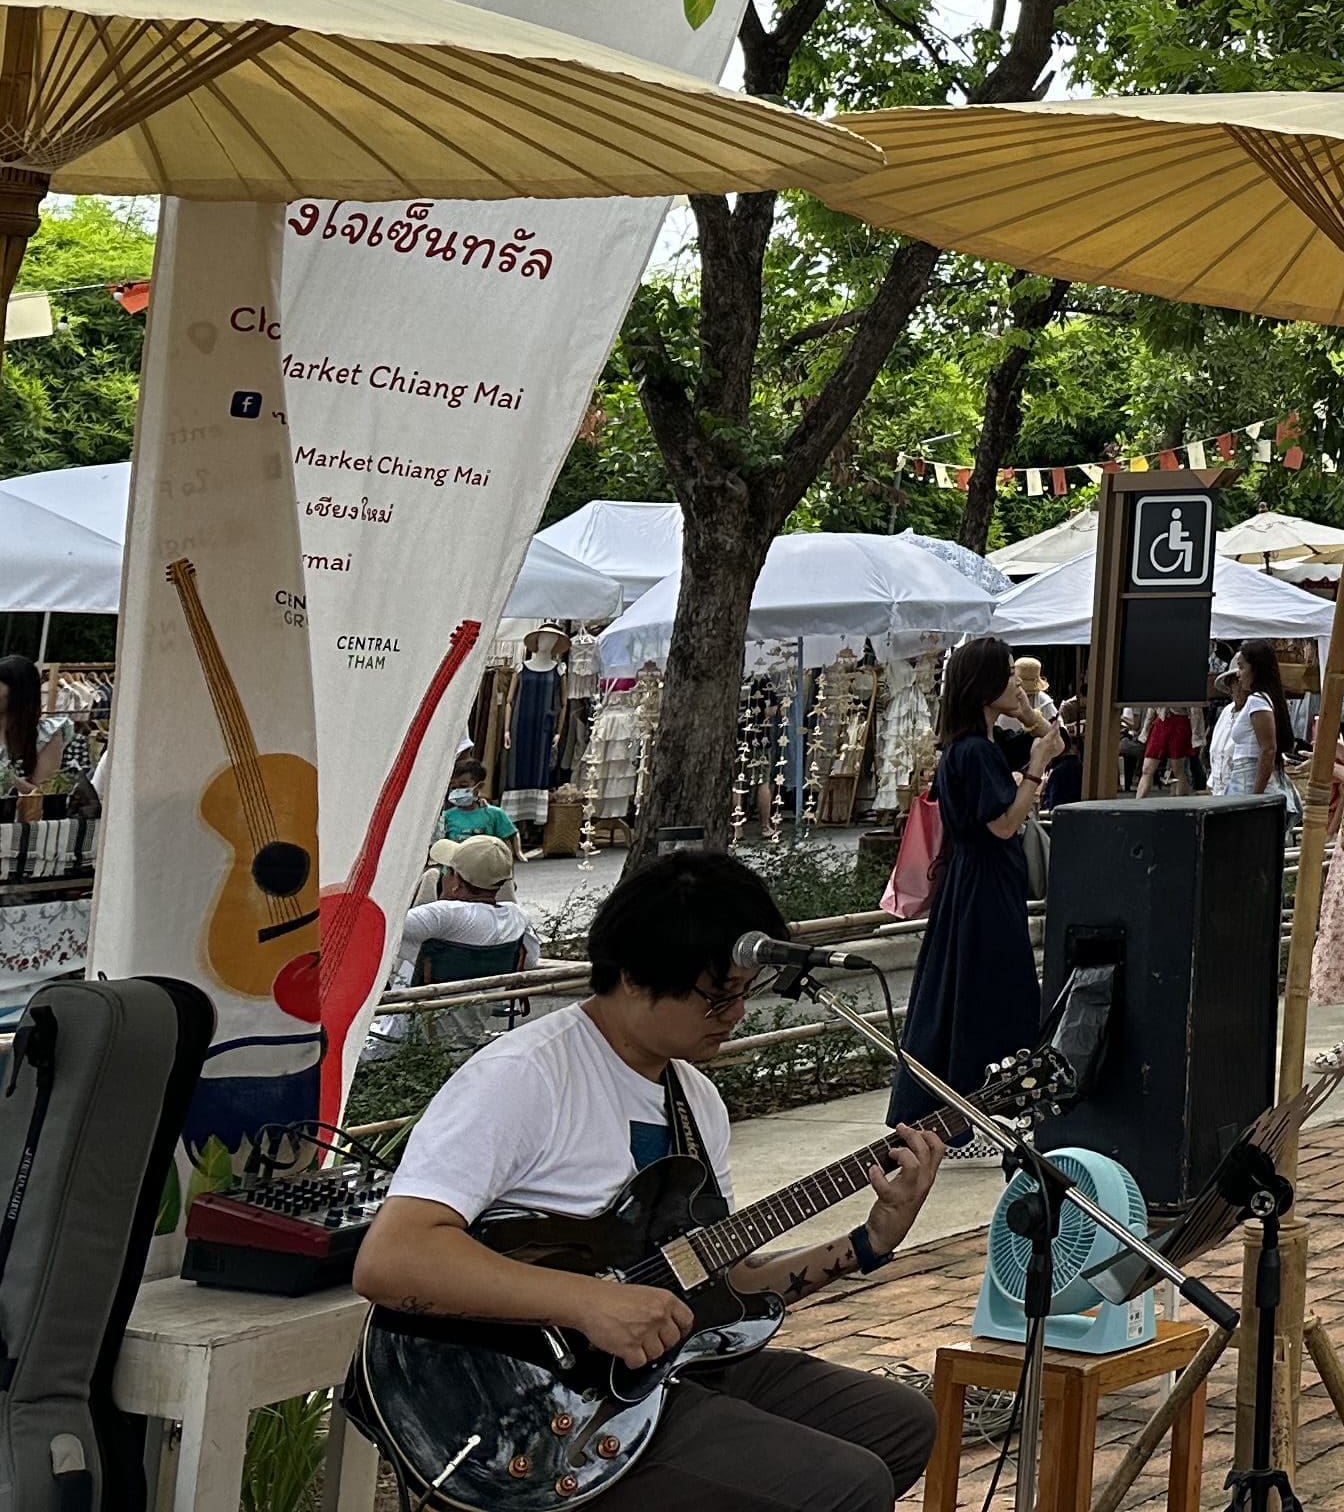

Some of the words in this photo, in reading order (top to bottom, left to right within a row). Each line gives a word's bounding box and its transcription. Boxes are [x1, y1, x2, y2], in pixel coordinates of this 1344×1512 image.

[369, 365, 468, 408] Chiang
[474, 381, 525, 410] Mai
[294, 445, 373, 473] Market
[377, 456, 450, 487] Chiang
[454, 465, 492, 487] Mai
[305, 496, 394, 523] เชียงใหม่
[336, 635, 401, 653] CENTRAL
[347, 654, 386, 670] THAM
